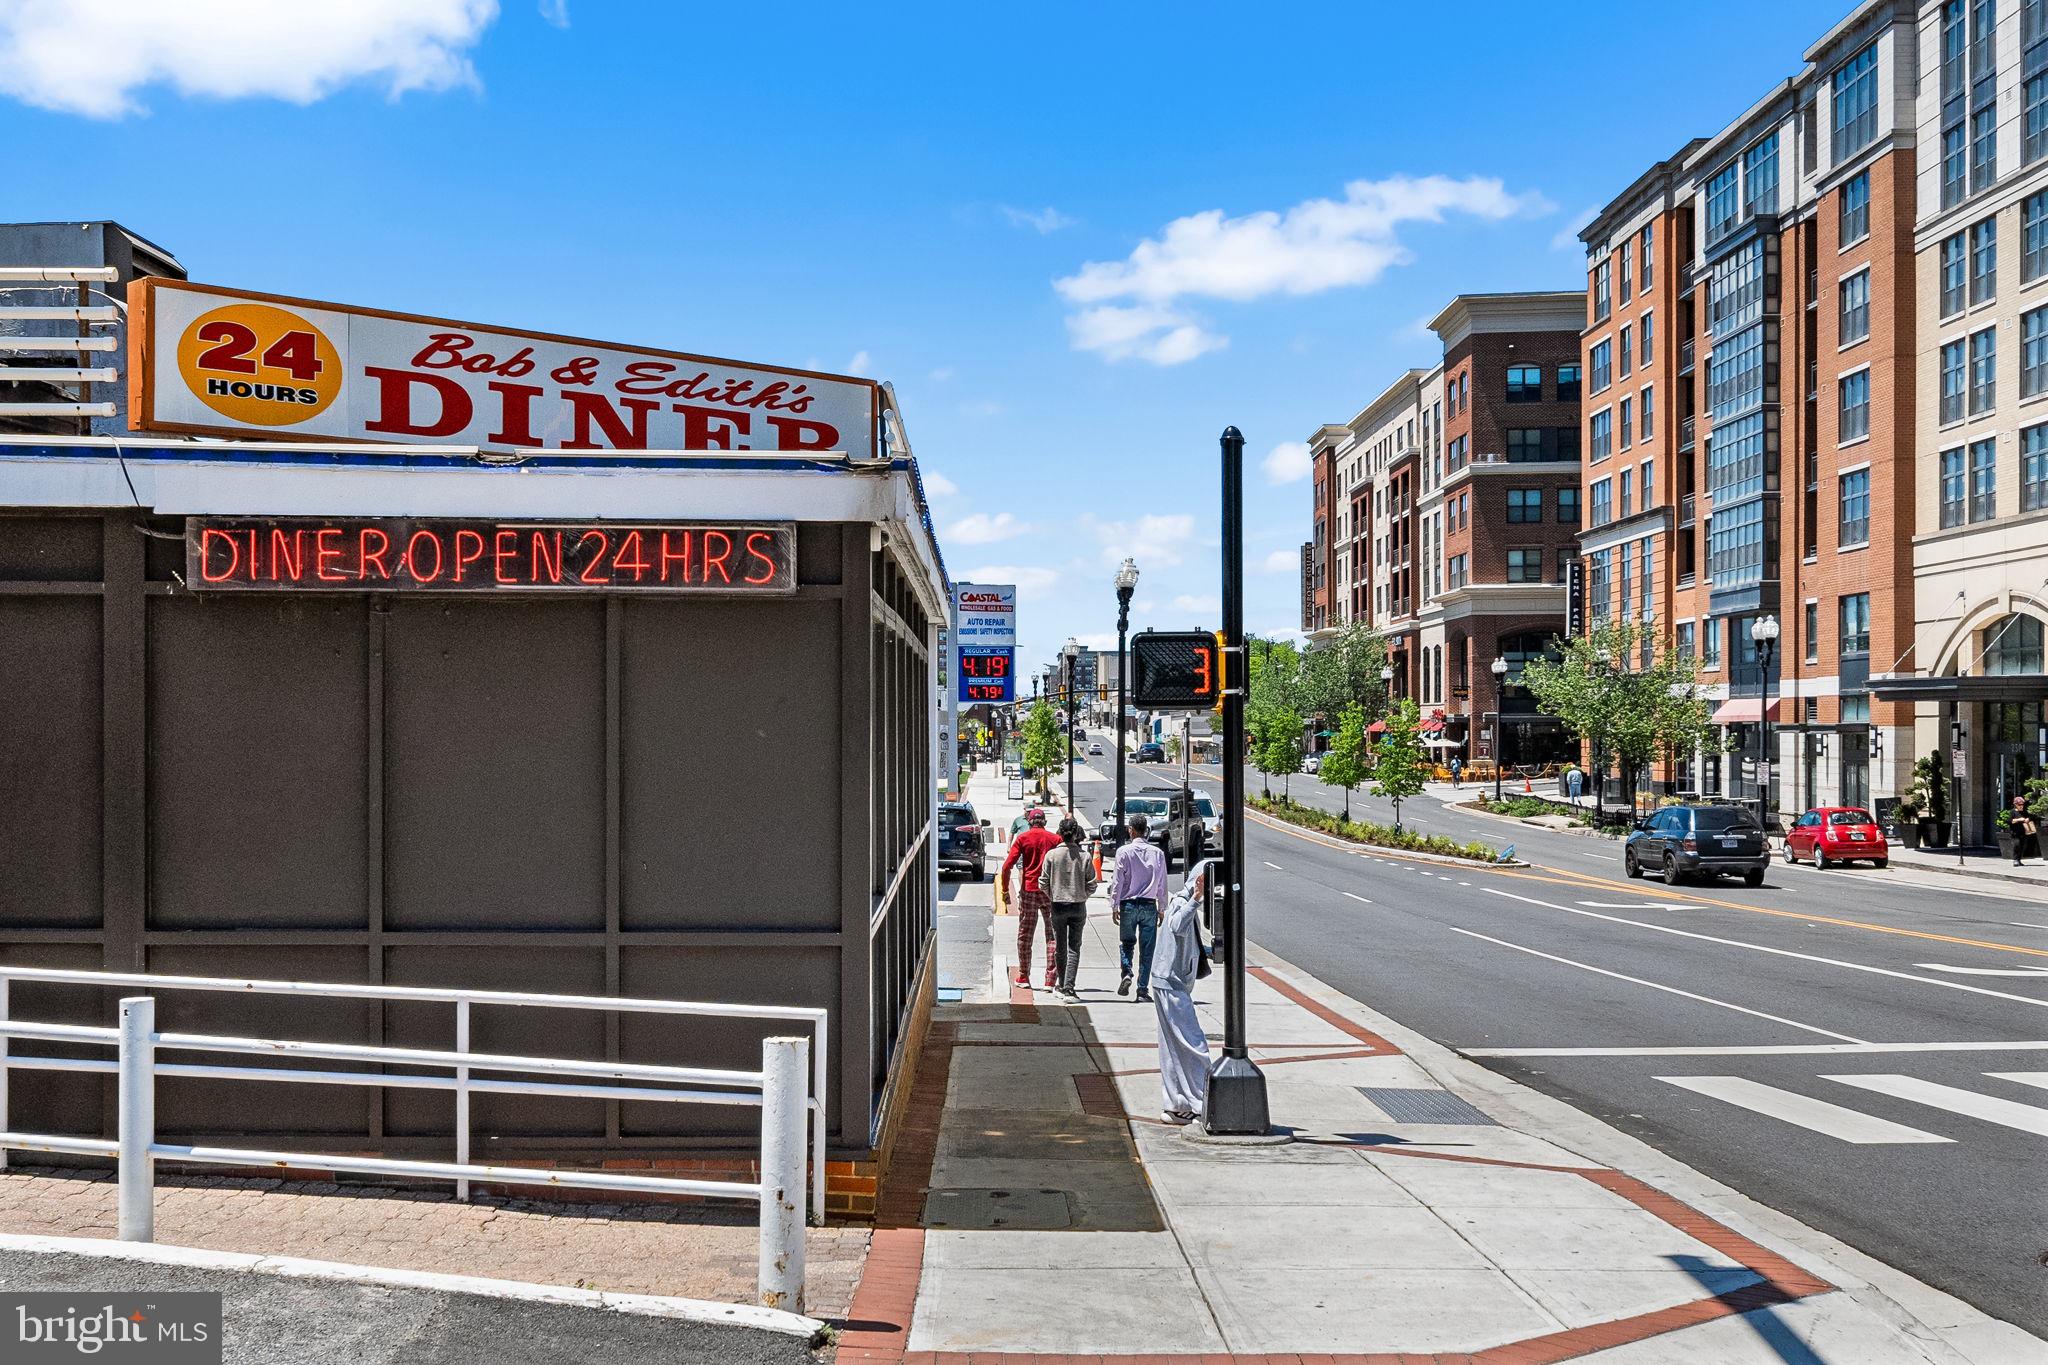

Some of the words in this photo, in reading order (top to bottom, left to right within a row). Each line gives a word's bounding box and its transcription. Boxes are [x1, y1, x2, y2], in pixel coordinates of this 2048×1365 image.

[197, 321, 323, 381] 24
[411, 333, 536, 377] Bob
[550, 357, 600, 386] &
[614, 361, 815, 413] Edith's
[207, 378, 318, 405] HOURS
[365, 366, 840, 450] DINER
[960, 592, 1002, 602] COASTAL
[967, 618, 984, 626] AUTO
[984, 618, 1006, 626] REPAIR
[1193, 647, 1211, 694] 3
